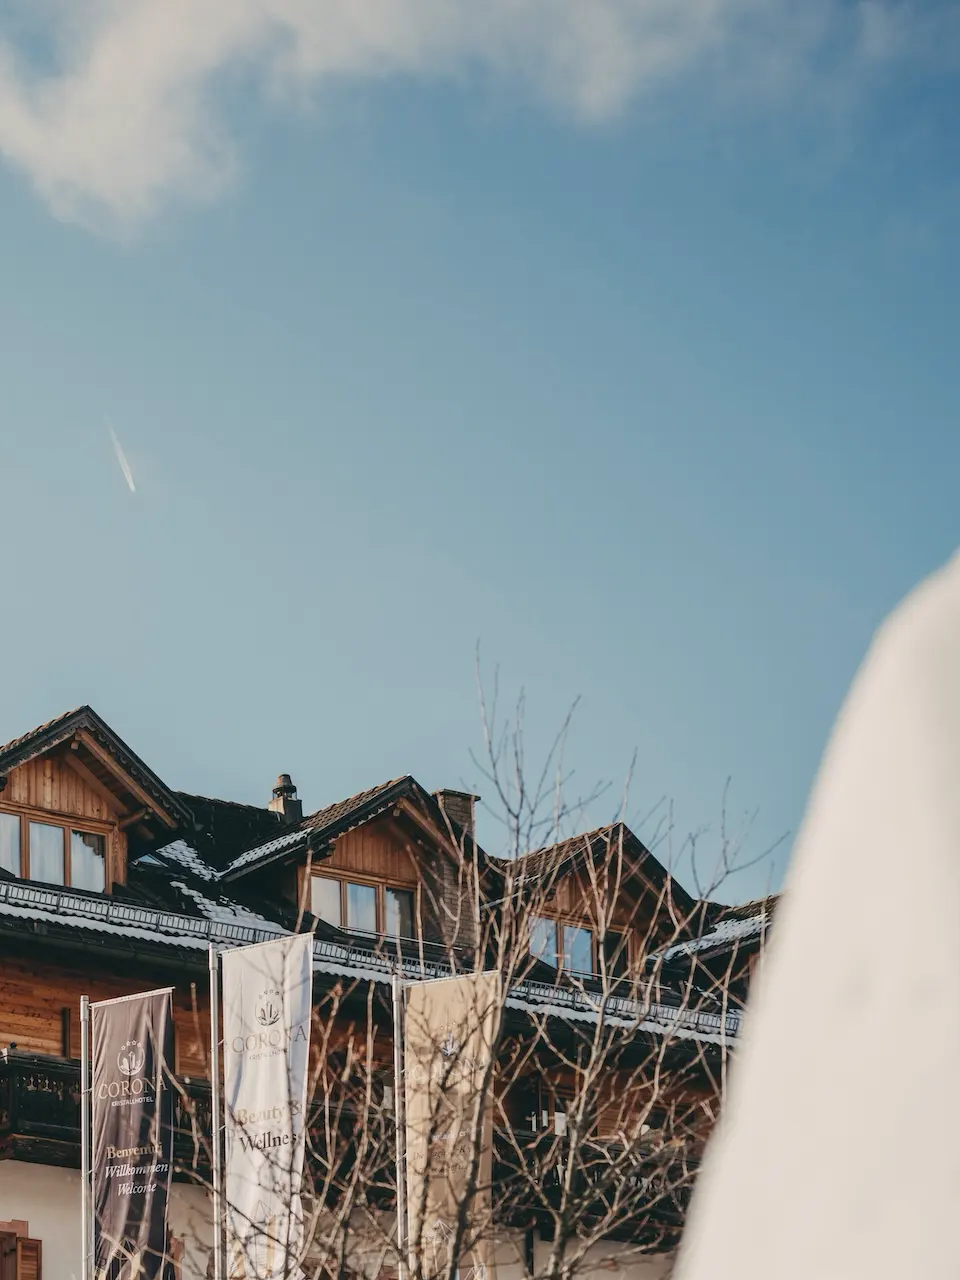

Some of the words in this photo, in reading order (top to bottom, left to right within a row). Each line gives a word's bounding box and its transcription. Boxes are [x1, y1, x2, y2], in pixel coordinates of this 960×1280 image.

[99, 1077, 168, 1099] CORONA
[111, 1096, 154, 1107] KRISTALLHOTEL
[105, 1163, 169, 1179] Willkommen
[117, 1182, 157, 1197] Welcome
